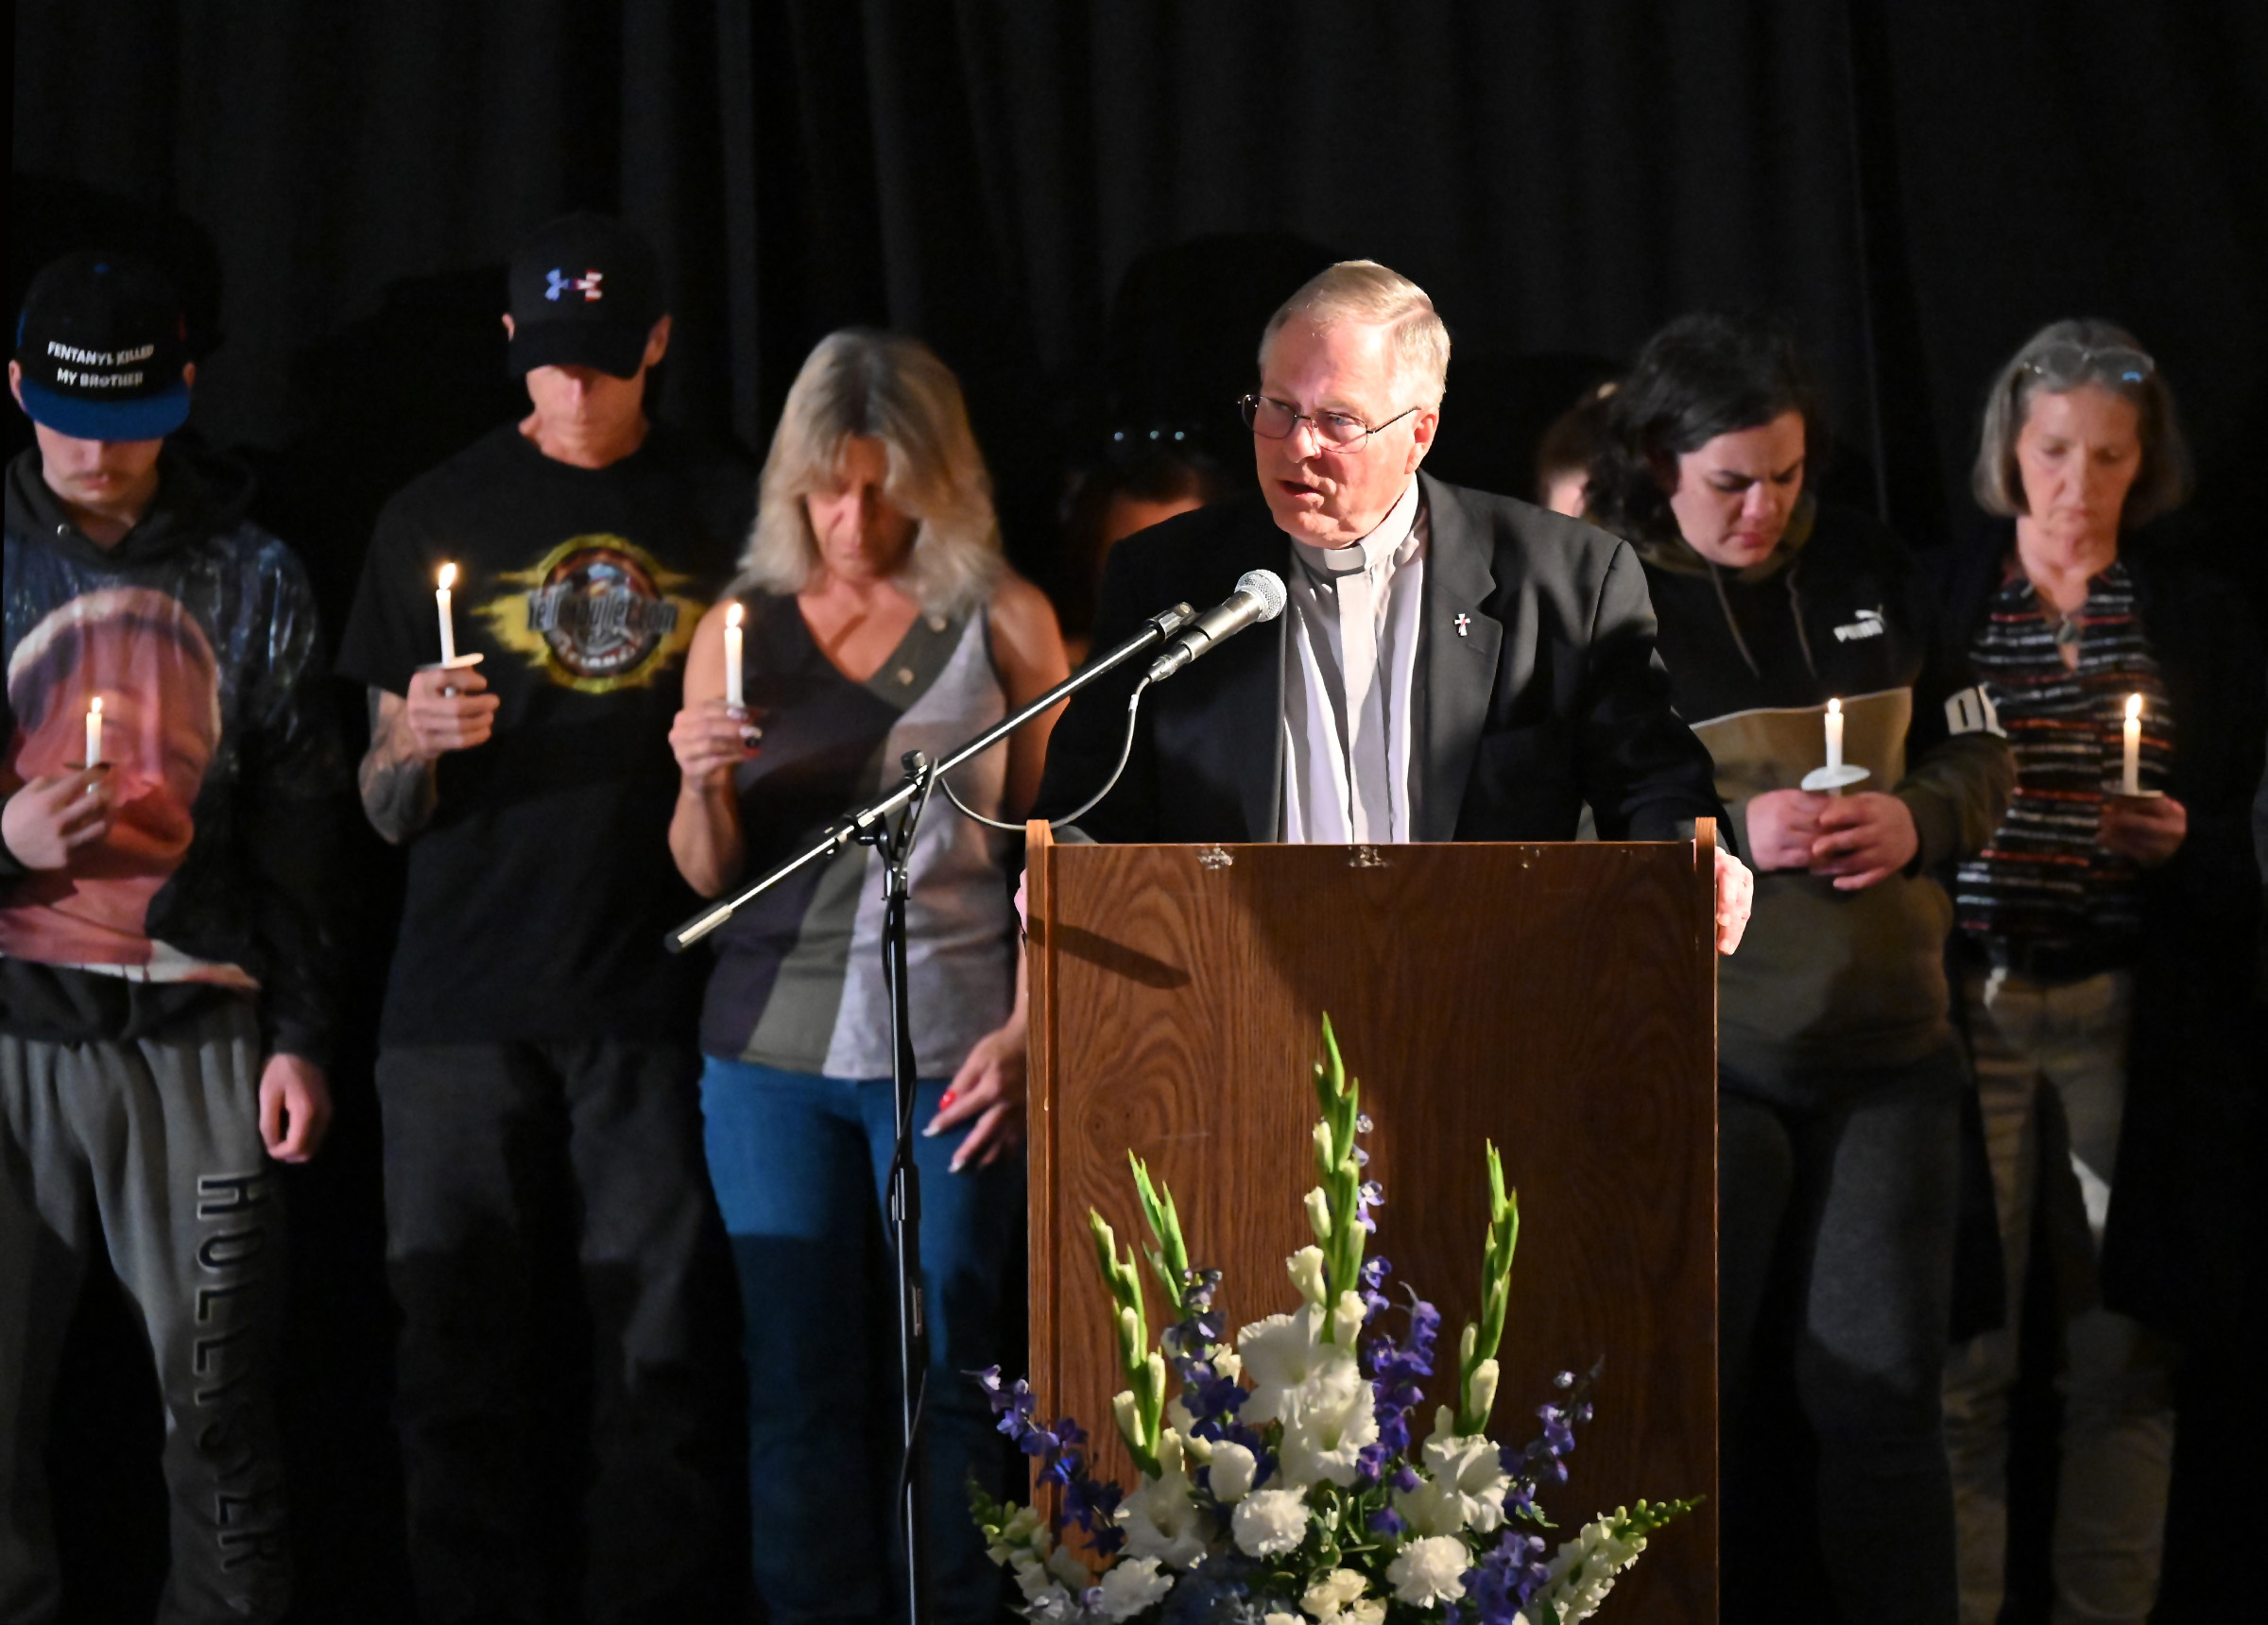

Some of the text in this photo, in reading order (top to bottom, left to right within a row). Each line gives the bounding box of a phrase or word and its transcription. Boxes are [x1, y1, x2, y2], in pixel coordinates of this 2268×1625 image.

[47, 341, 114, 366] FENTANYL
[57, 367, 144, 388] MY BROTHER
